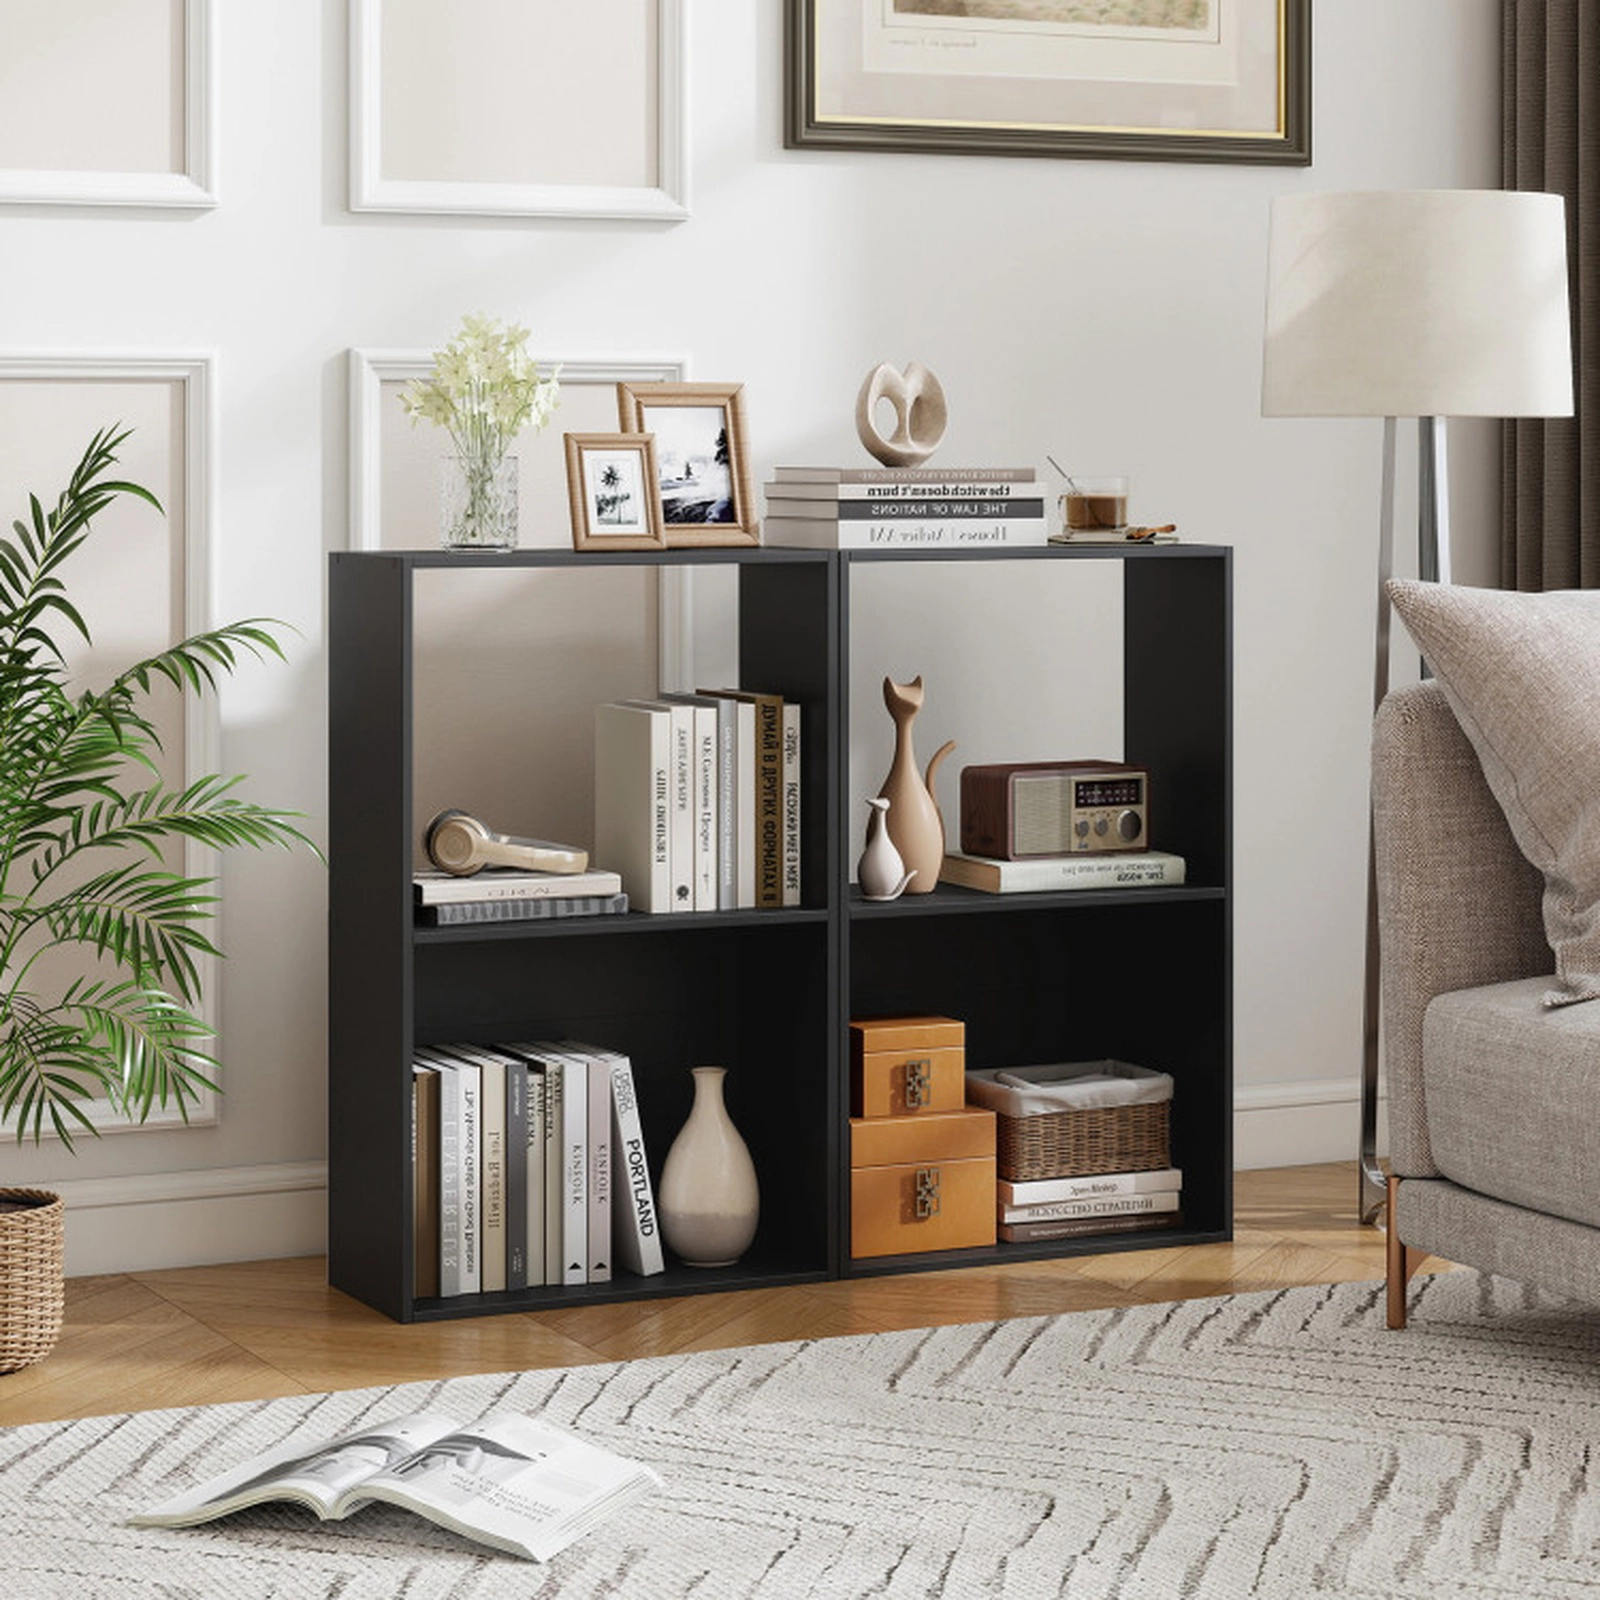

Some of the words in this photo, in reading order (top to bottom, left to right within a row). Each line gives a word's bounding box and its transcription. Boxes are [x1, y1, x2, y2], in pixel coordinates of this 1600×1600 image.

[762, 704, 778, 750] ДУМАЙ
[763, 754, 776, 763] В
[762, 766, 776, 816] ДРУГИХ
[762, 820, 777, 890] ФОРМАТАХ
[786, 864, 798, 890] МОРЕ
[572, 1144, 583, 1205] KINFOLK
[597, 1144, 608, 1205] KINFOLK
[626, 1138, 655, 1238] PORTLAND
